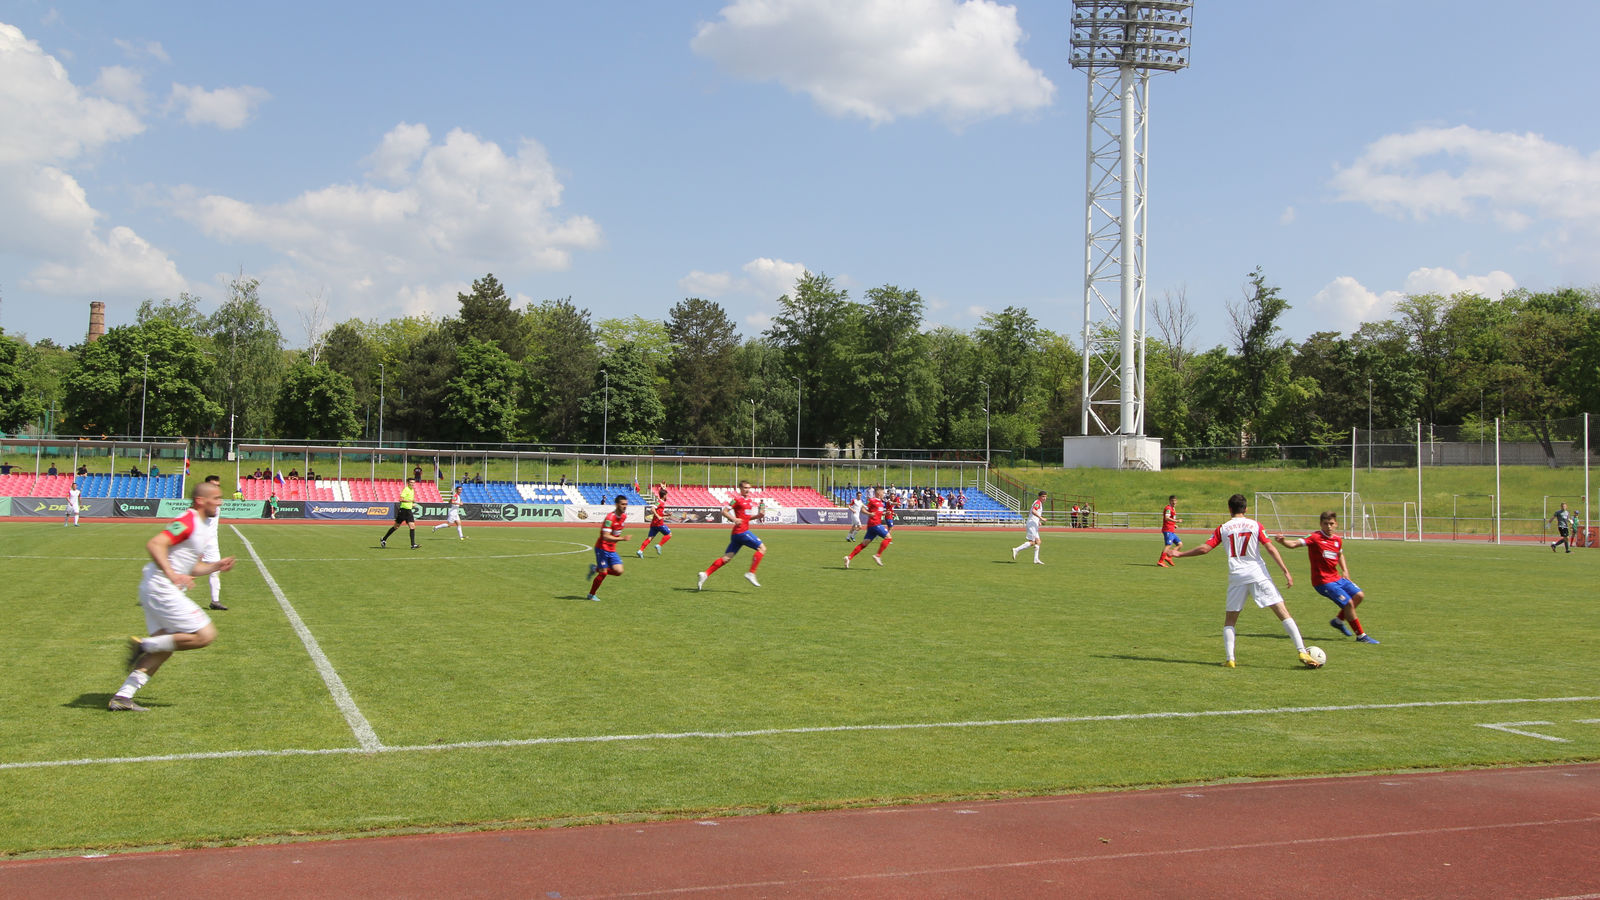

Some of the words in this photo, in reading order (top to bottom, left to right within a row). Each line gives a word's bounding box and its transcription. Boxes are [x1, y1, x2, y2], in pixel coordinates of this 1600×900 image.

[425, 508, 467, 516] ЛИА
[504, 507, 516, 517] 2
[521, 508, 563, 517] ЛИГА
[1228, 532, 1252, 557] 17
